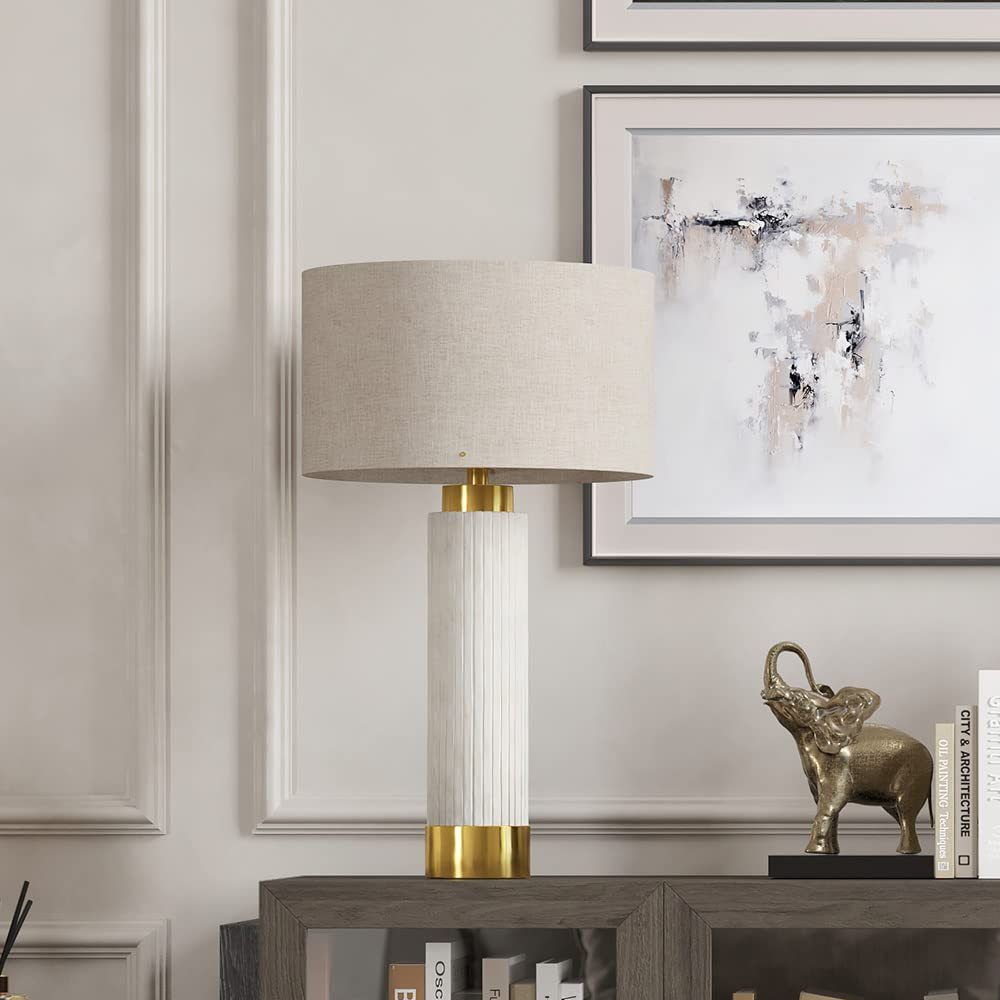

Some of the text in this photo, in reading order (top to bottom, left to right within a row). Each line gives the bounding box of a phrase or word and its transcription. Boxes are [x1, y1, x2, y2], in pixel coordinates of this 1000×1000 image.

[960, 709, 970, 838] CITY & ARCHITECTURE
